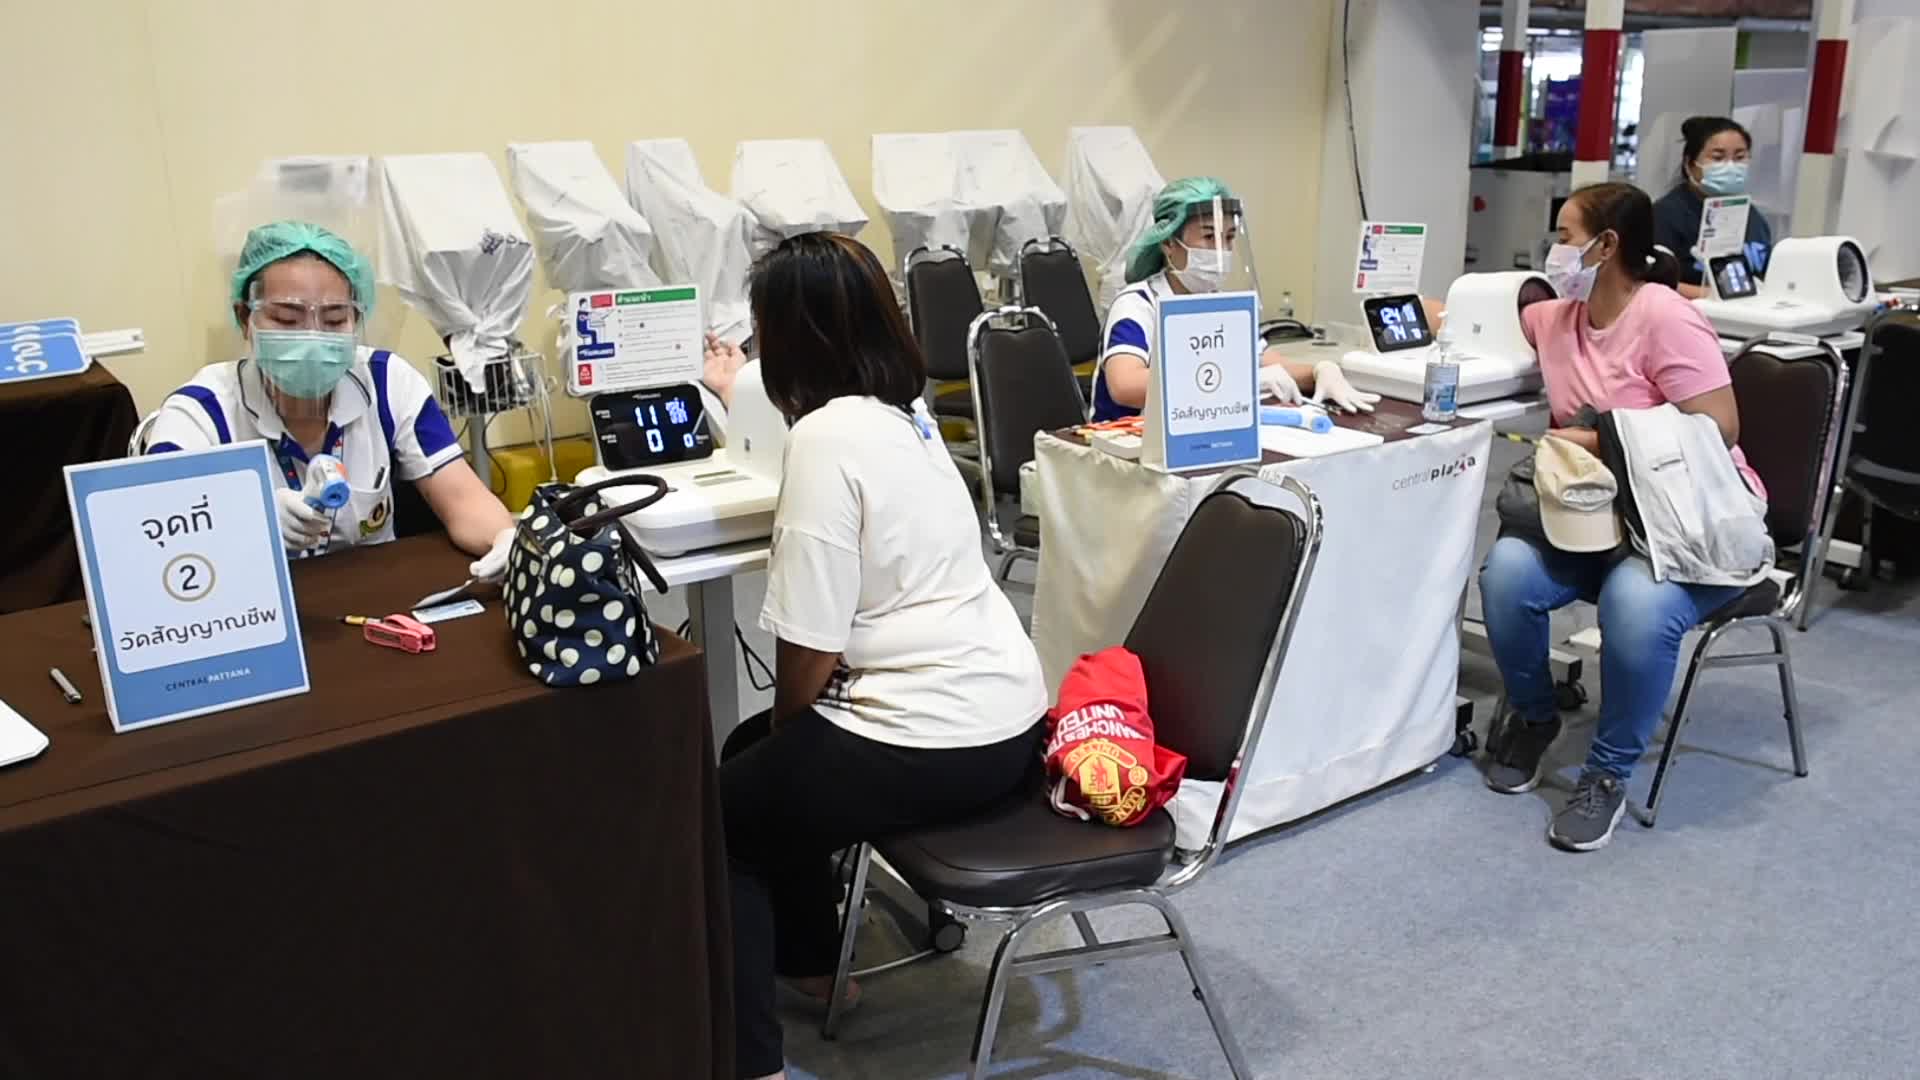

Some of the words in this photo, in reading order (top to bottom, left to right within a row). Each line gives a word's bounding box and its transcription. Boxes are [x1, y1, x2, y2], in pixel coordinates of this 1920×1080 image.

[1190, 325, 1224, 355] จุดที่
[1204, 369, 1213, 385] 2
[141, 495, 213, 547] จุดที่
[179, 565, 200, 590] 2
[119, 607, 278, 651] วัดสัญญาณชีพ
[1057, 704, 1125, 736] UNITED
